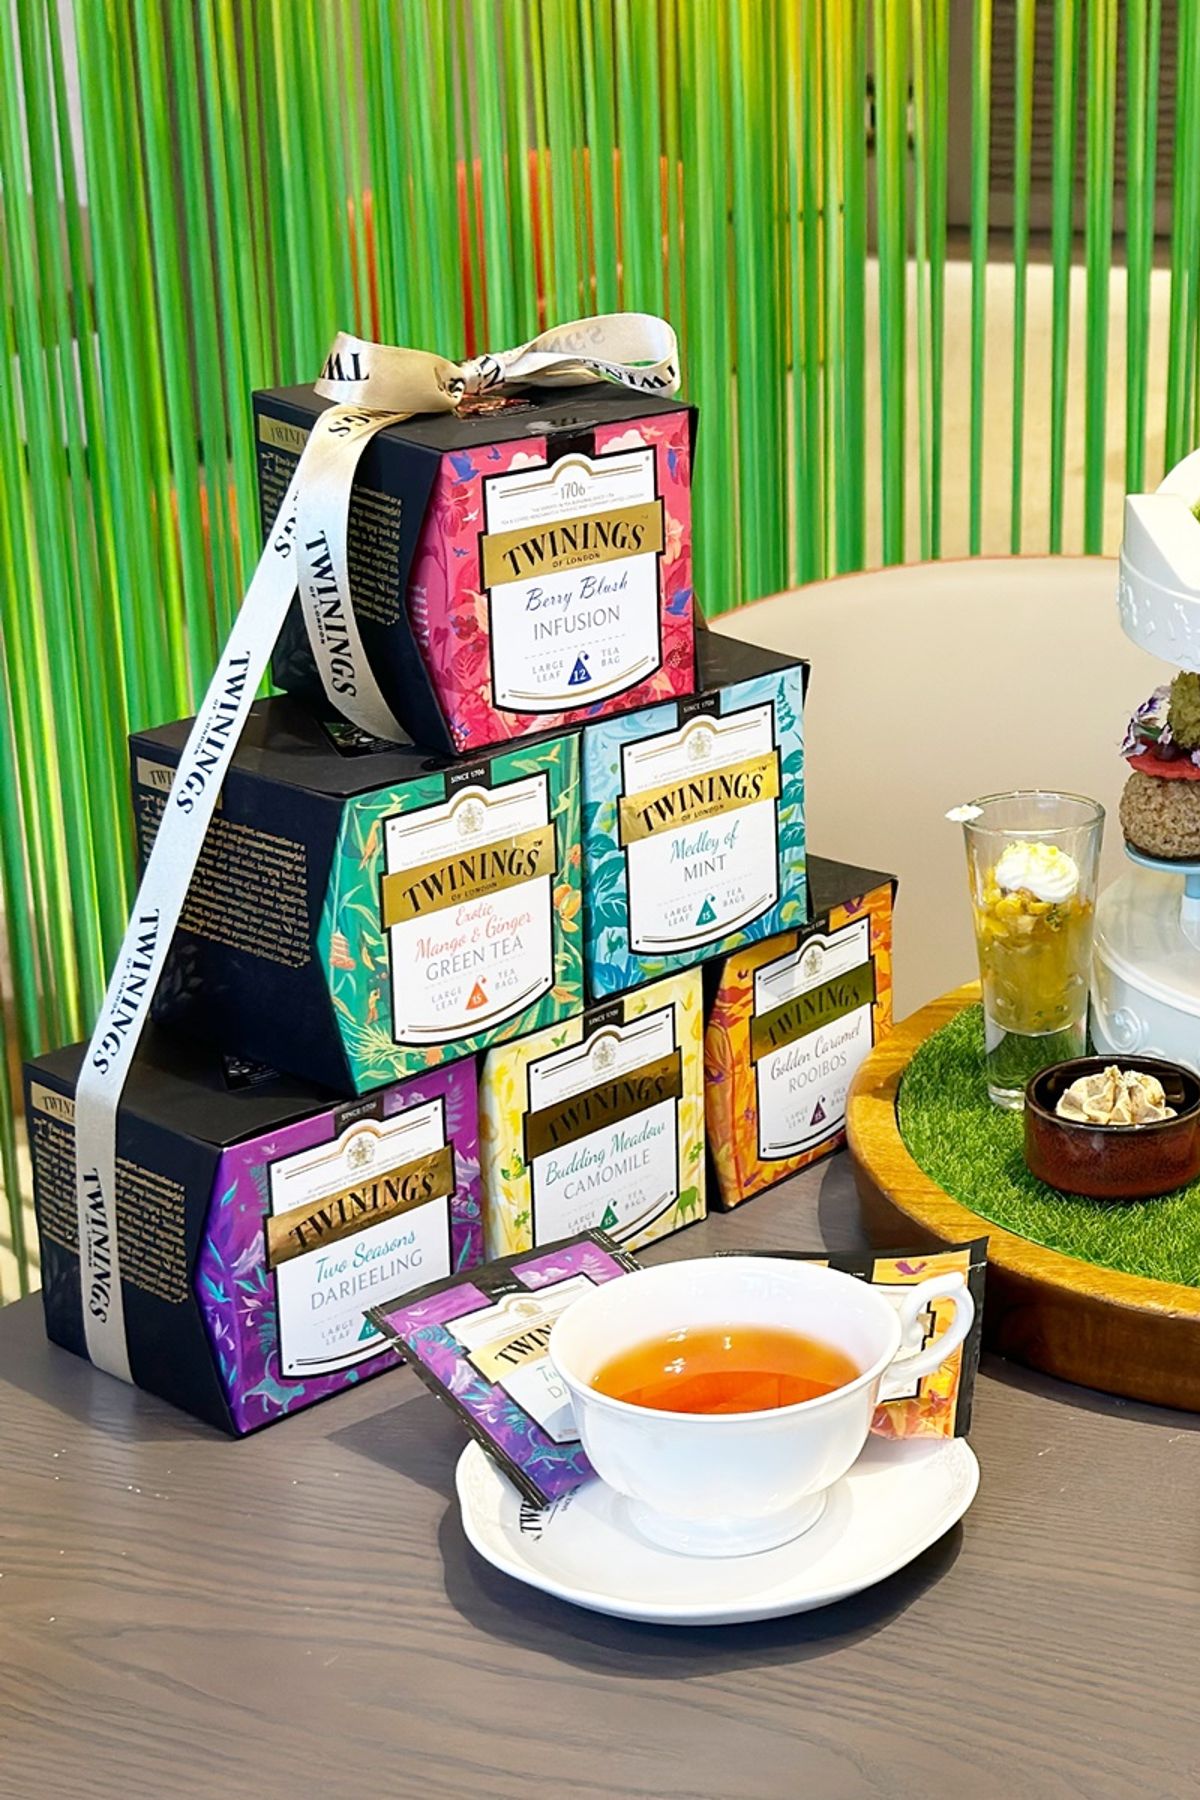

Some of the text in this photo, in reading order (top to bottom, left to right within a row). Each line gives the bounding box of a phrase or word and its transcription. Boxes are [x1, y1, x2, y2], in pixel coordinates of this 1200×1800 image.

[560, 481, 586, 500] 1706
[502, 520, 645, 577] TWININGS
[551, 552, 601, 569] OF LONDON
[305, 530, 357, 697] TWININGS
[525, 571, 629, 613] Berry Blush
[533, 604, 621, 641] INFUSION
[532, 659, 565, 675] LARGE
[573, 668, 587, 682] 12
[600, 655, 621, 668] BAG
[601, 647, 620, 657] TEA
[536, 670, 561, 684] LEAF
[176, 650, 251, 814] TWININGS
[637, 773, 765, 833] TWININGS
[670, 819, 740, 863] Medley of
[402, 848, 540, 913] TWININGS
[684, 853, 727, 882] MINT
[415, 936, 466, 963] Mango
[485, 912, 532, 938] Ginger
[455, 903, 494, 927] Exotic
[425, 936, 524, 981] GREEN TEA
[93, 908, 160, 1075] TWININGS
[766, 985, 860, 1046] TWININGS
[770, 1016, 862, 1081] Golden Caramel
[788, 1051, 848, 1093] ROOIBOS
[547, 1076, 667, 1143] TWININGS
[545, 1119, 665, 1186] Budding Meadow
[563, 1148, 651, 1200] CAMOMILE
[289, 1171, 435, 1249] TWININGS
[83, 1168, 111, 1324] TWININGS
[315, 1229, 417, 1284] Two Seasons
[311, 1248, 424, 1311] DARJEELING
[321, 1319, 355, 1339] LARGE
[325, 1330, 352, 1346] LEAF
